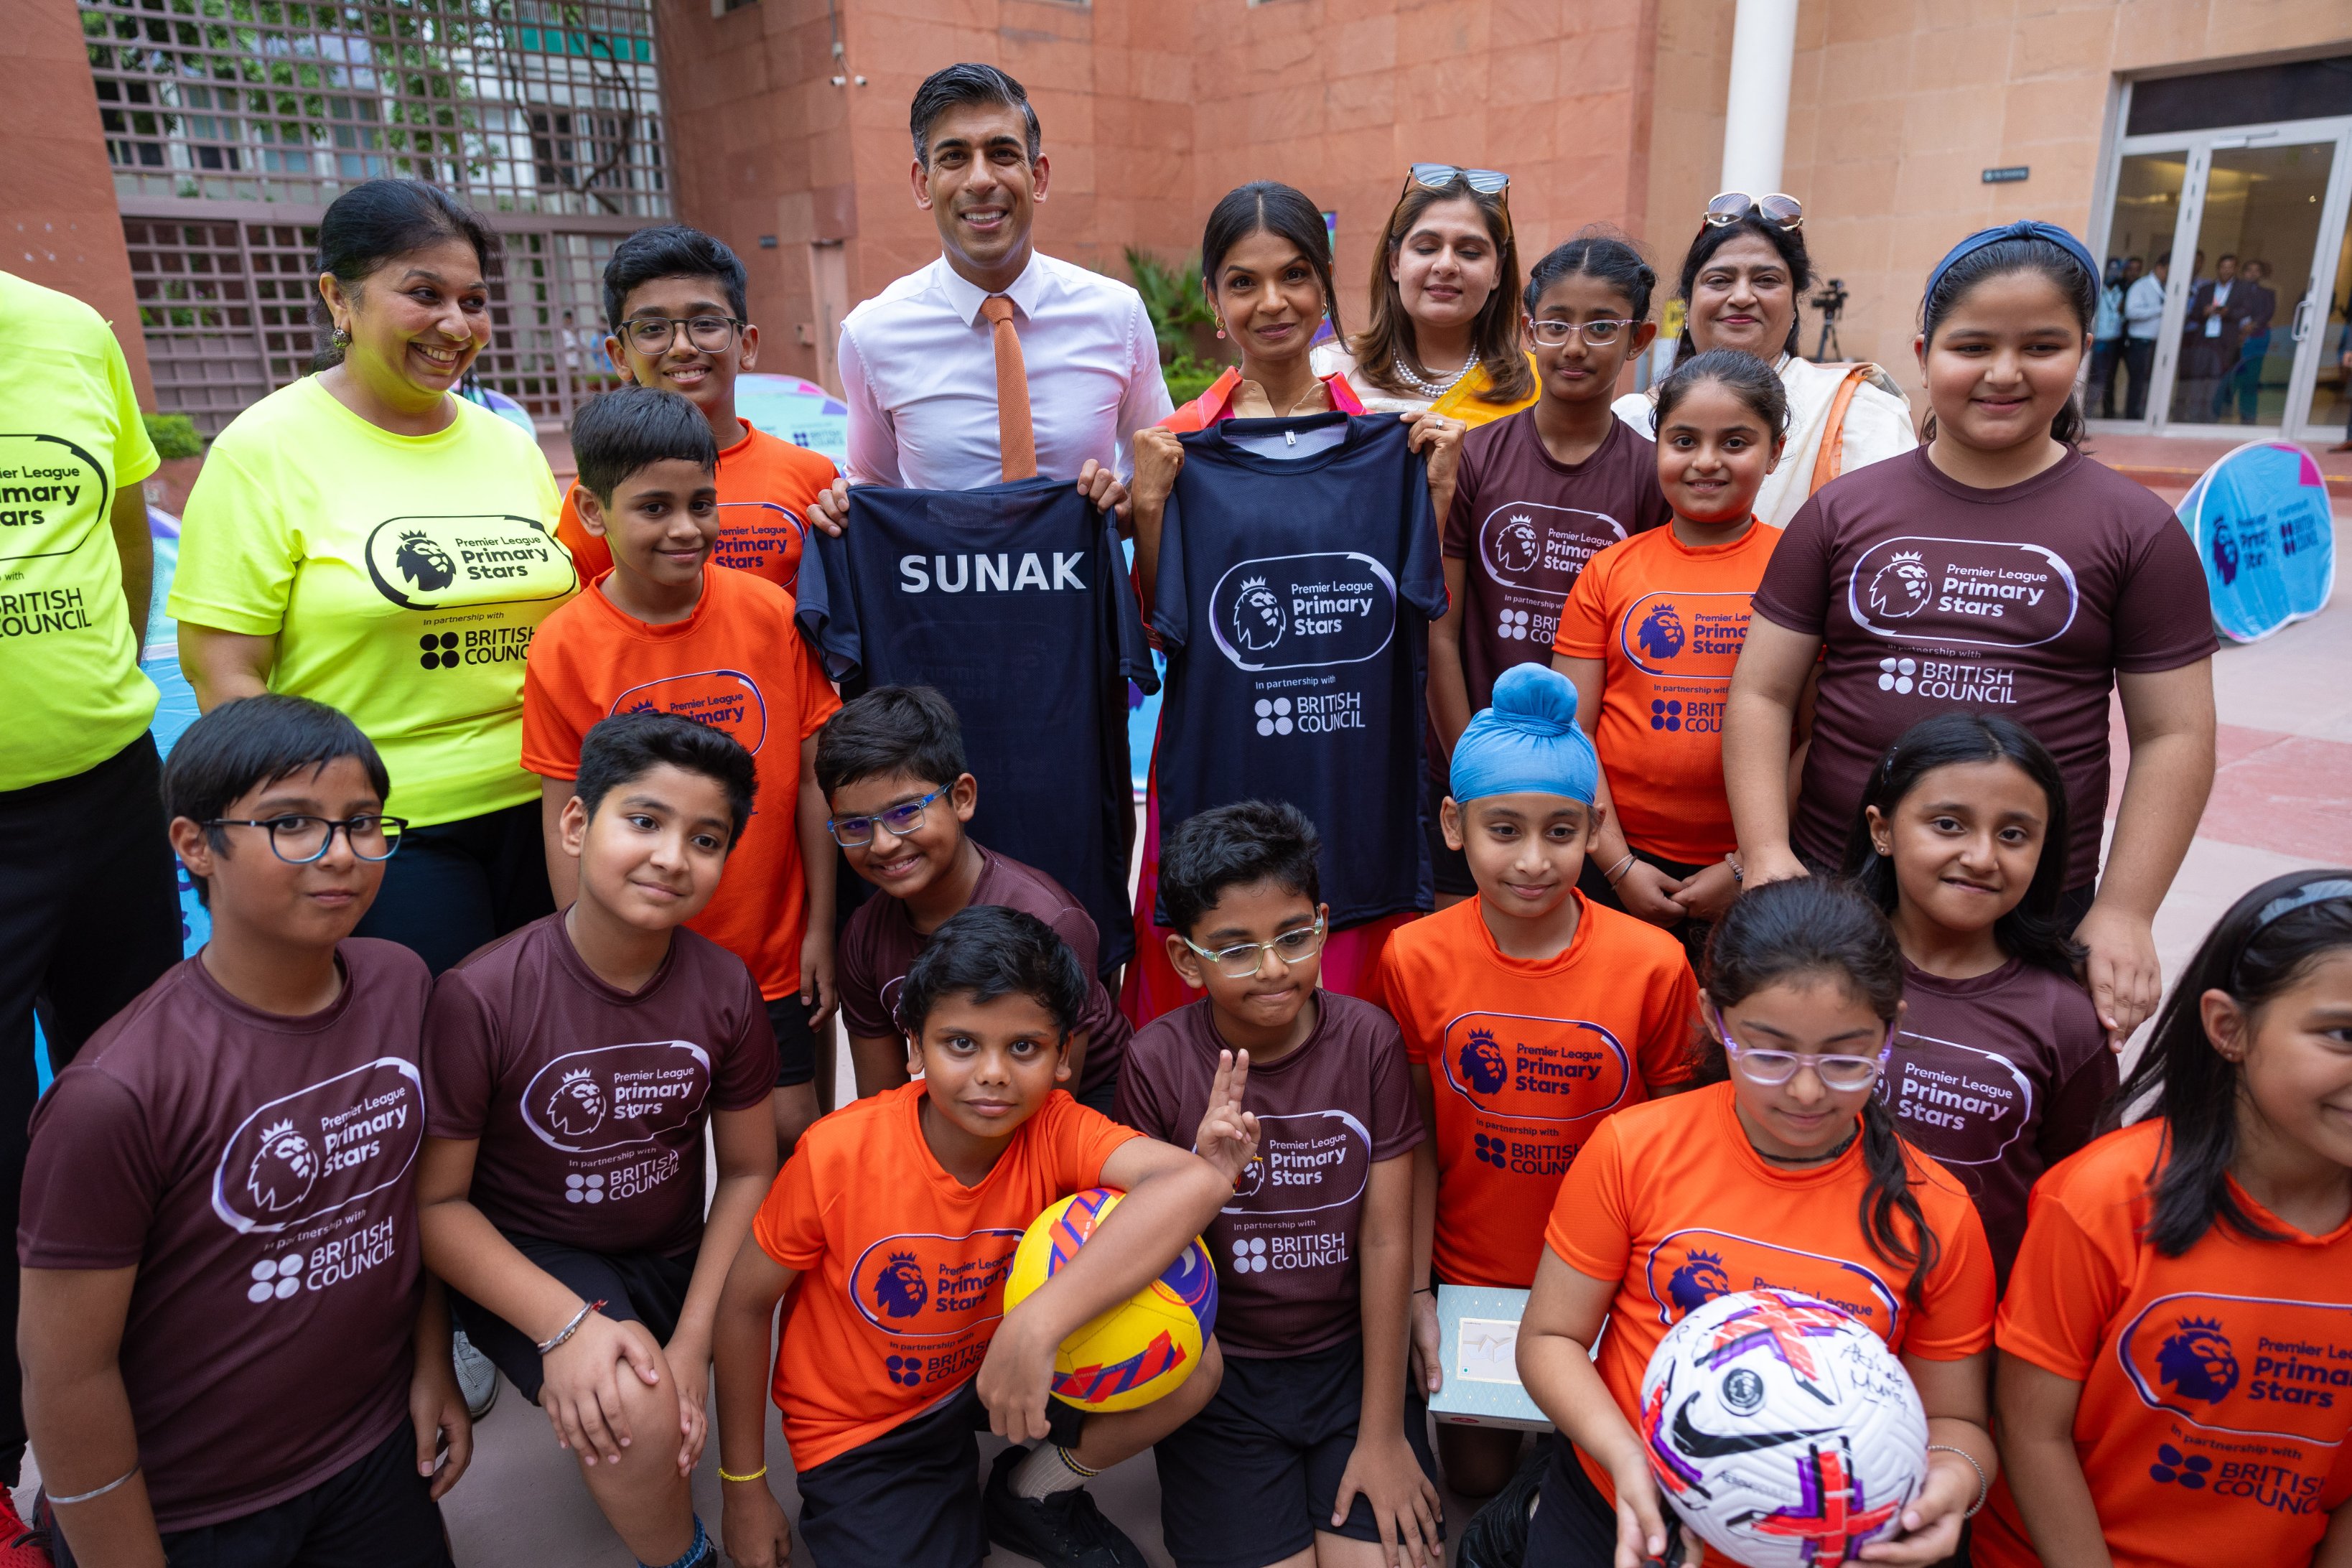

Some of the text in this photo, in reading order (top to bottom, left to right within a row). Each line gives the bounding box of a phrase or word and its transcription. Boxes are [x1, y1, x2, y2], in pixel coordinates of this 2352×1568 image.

[22, 466, 80, 480] League
[0, 485, 80, 505] mary
[0, 510, 45, 526] ars
[719, 526, 787, 536] remier League
[1548, 528, 1613, 547] Premier League
[455, 536, 541, 547] Premier League
[714, 537, 787, 554] Primary
[1546, 540, 1598, 559] Primar
[461, 546, 549, 564] Primary
[715, 555, 764, 569] Stars
[1544, 555, 1584, 574] Stars
[5, 571, 24, 581] with
[467, 564, 528, 580] Stars
[900, 551, 1087, 593] SUNAK
[1946, 564, 2048, 583] Premier League
[1292, 581, 1373, 594] Premier League
[1942, 577, 2044, 606] Primary
[0, 588, 83, 615] RITISH
[1292, 595, 1373, 616] Primary
[1513, 597, 1554, 609] partnership
[1938, 596, 2005, 617] Stars
[0, 609, 92, 638] OUNCIL
[434, 612, 485, 626] partnership
[1294, 617, 1343, 635] Stars
[1695, 613, 1732, 622] Premier
[1694, 623, 1748, 639] Prima
[465, 644, 530, 665] COUNC
[1692, 640, 1744, 655] Stars
[1959, 649, 1982, 658] with
[1256, 675, 1336, 690] In partnership with
[1922, 661, 2015, 685] BRITISH
[1663, 686, 1712, 695] partnership
[1918, 681, 2017, 704] COUNCIL
[670, 694, 744, 712] Premier League
[1297, 692, 1361, 714] BRITISH
[1686, 701, 1727, 717] BRIT
[689, 706, 745, 724] imary
[1297, 711, 1366, 733] COUNCIL
[1516, 1043, 1603, 1061] Premier League
[614, 1067, 694, 1083] Premier League
[1516, 1057, 1602, 1081] Primary
[1515, 1075, 1571, 1095] Stars
[1905, 1062, 2013, 1099] Premier League
[615, 1081, 693, 1103] Primary
[1901, 1078, 2010, 1121] Primary
[321, 1087, 406, 1131] Premier League
[614, 1102, 663, 1119] Stars
[1898, 1099, 1966, 1131] Stars
[325, 1103, 408, 1156] Primary
[1485, 1120, 1537, 1137] partnership
[1539, 1128, 1559, 1137] with
[1269, 1134, 1347, 1150] Premier League
[323, 1139, 381, 1178] Stars
[581, 1151, 635, 1168] partnership
[610, 1149, 678, 1186] BRITISH
[1271, 1147, 1347, 1169] Primary
[1511, 1159, 1573, 1175] COUN
[609, 1162, 680, 1201] COUNCIL
[1272, 1170, 1322, 1186] Stars
[345, 1209, 366, 1223] with
[1244, 1221, 1296, 1231] partnership
[1297, 1219, 1316, 1228] with
[309, 1216, 393, 1270] BRITISH
[1271, 1232, 1345, 1254] BRITISH
[307, 1238, 396, 1291] COUNCIL
[939, 1261, 976, 1276] Premier
[1272, 1248, 1349, 1270] COUNCIL
[935, 1292, 987, 1312] Stars
[901, 1340, 955, 1351] partnership
[2259, 1337, 2323, 1356] Premier
[926, 1350, 986, 1383] COUNC
[2254, 1356, 2352, 1386] Prima
[2249, 1380, 2333, 1409] Stars
[2170, 1424, 2302, 1460] In partnership with
[2213, 1480, 2320, 1514] COUNC
